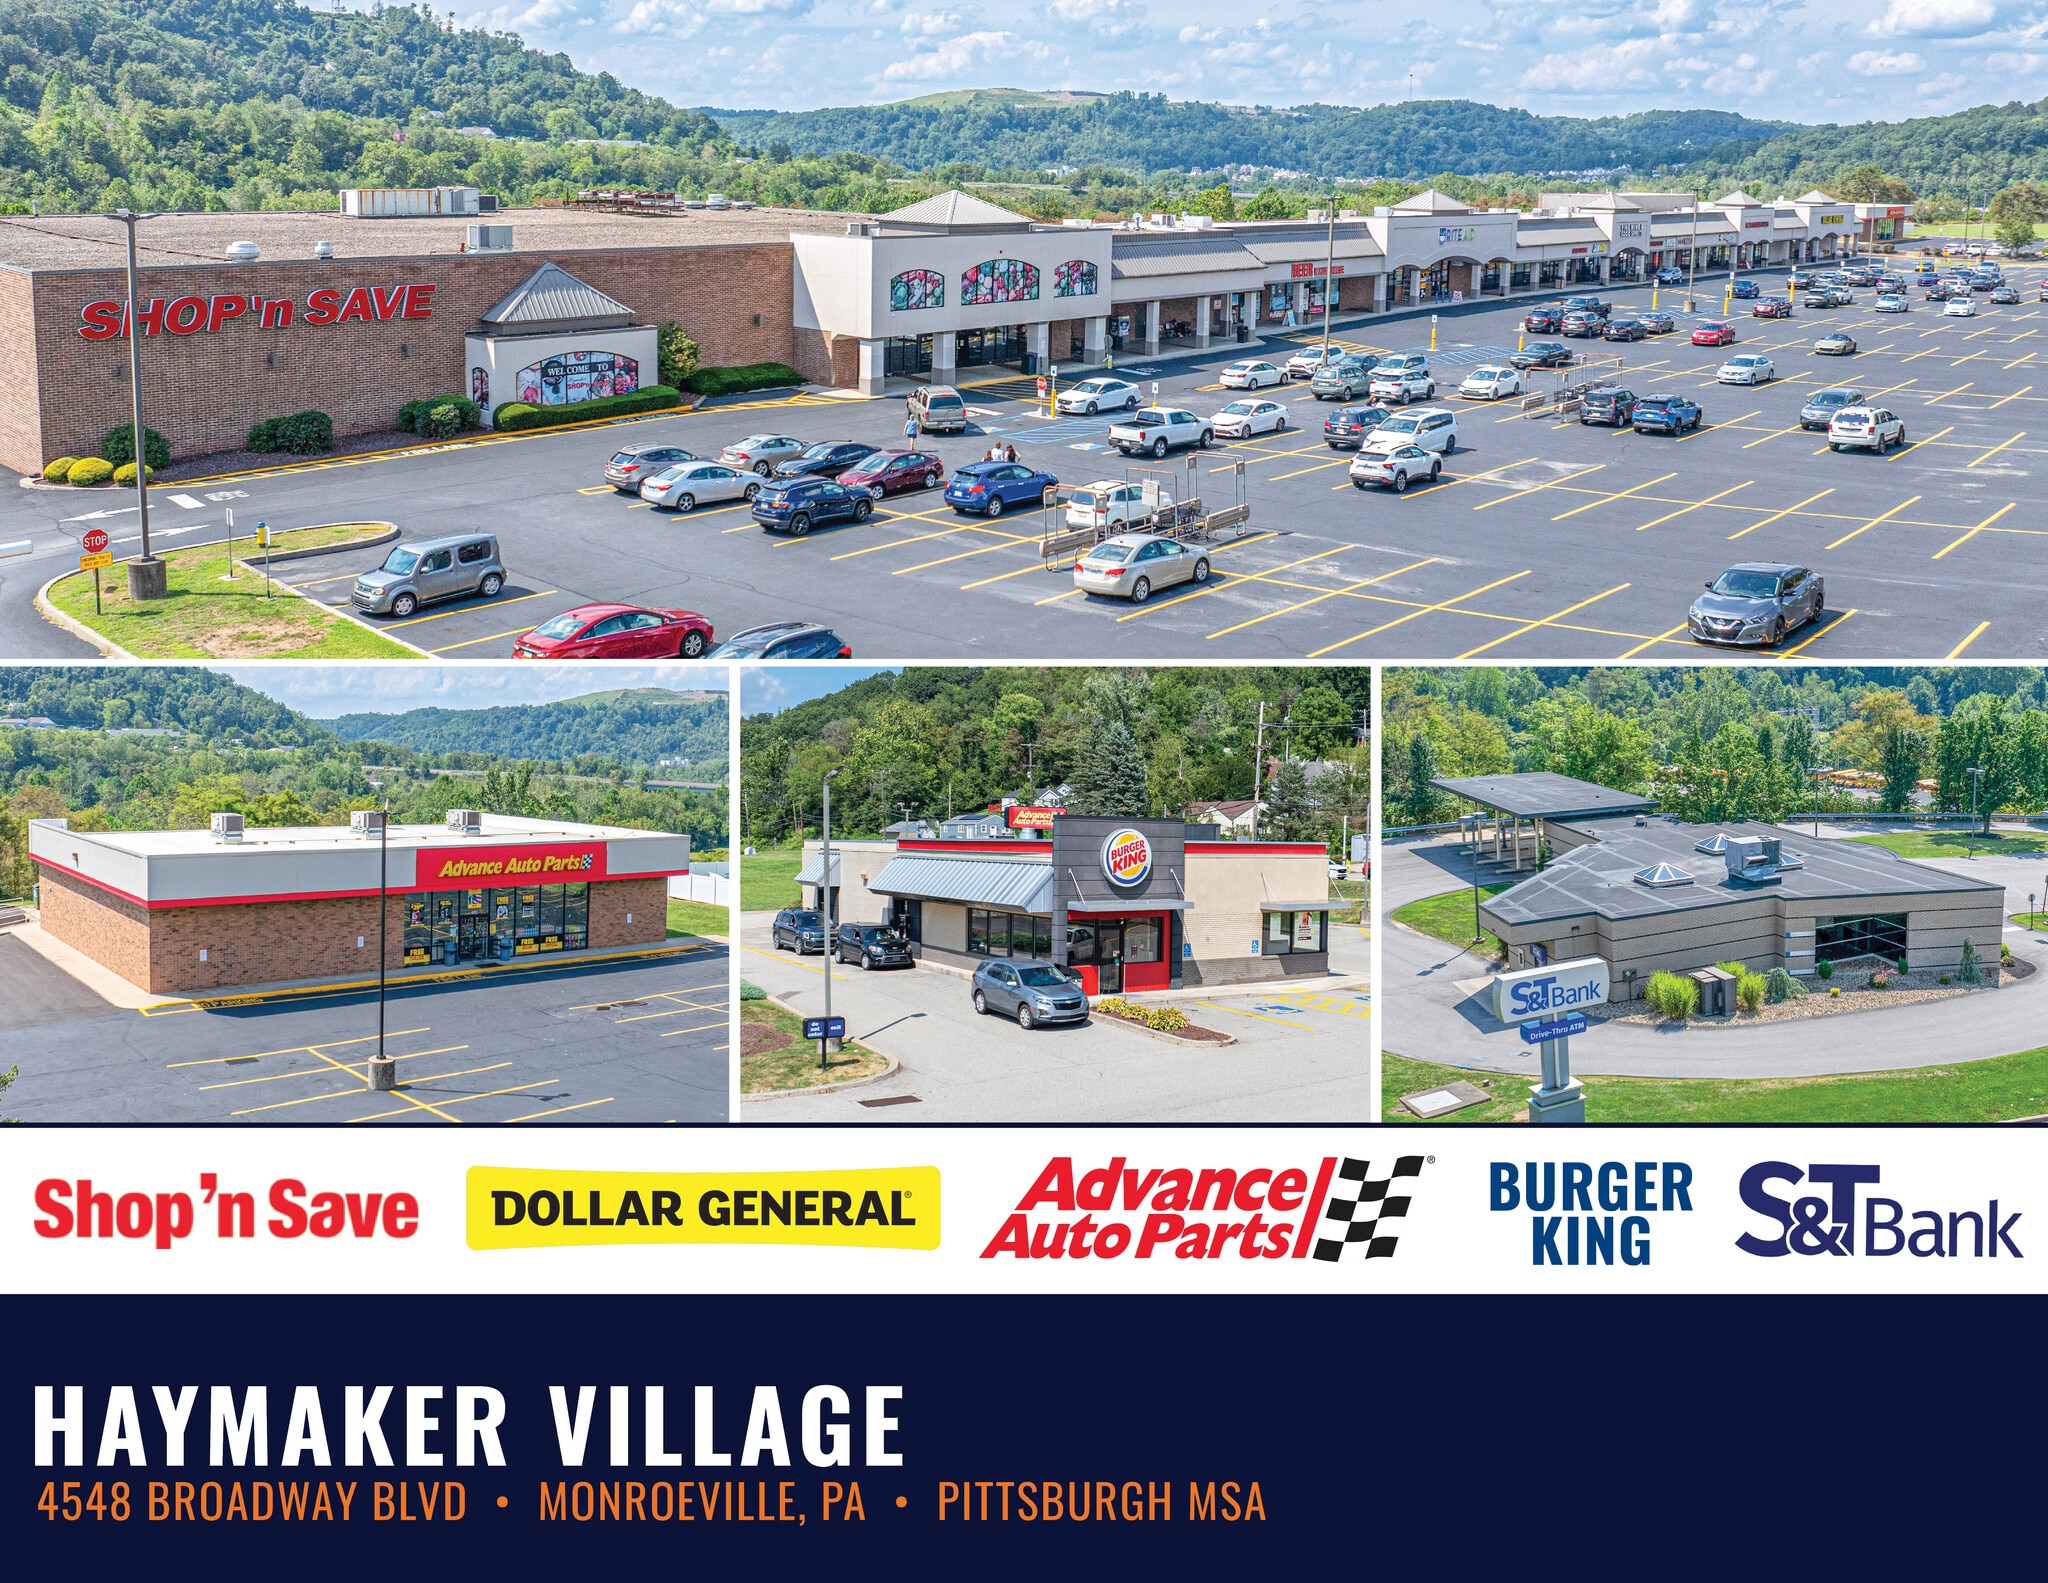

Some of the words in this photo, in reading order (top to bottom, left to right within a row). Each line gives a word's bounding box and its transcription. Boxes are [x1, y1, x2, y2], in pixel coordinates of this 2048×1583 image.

[1291, 263, 1314, 278] BEER
[77, 295, 294, 341] SHOP'n
[304, 284, 437, 326] SAVE
[547, 364, 590, 376] WELCOME
[597, 363, 609, 371] TO
[84, 535, 107, 547] STOP
[1017, 811, 1051, 819] Advance
[1111, 840, 1145, 860] BURGER
[437, 860, 502, 877] Advance
[503, 858, 541, 874] Auto
[543, 855, 582, 871] Parts
[1113, 849, 1146, 874] KING
[1510, 976, 1556, 1015] S&T
[1552, 980, 1601, 1007] Bank
[1530, 1027, 1568, 1040] Drive-Thru
[1569, 1022, 1585, 1031] ATM
